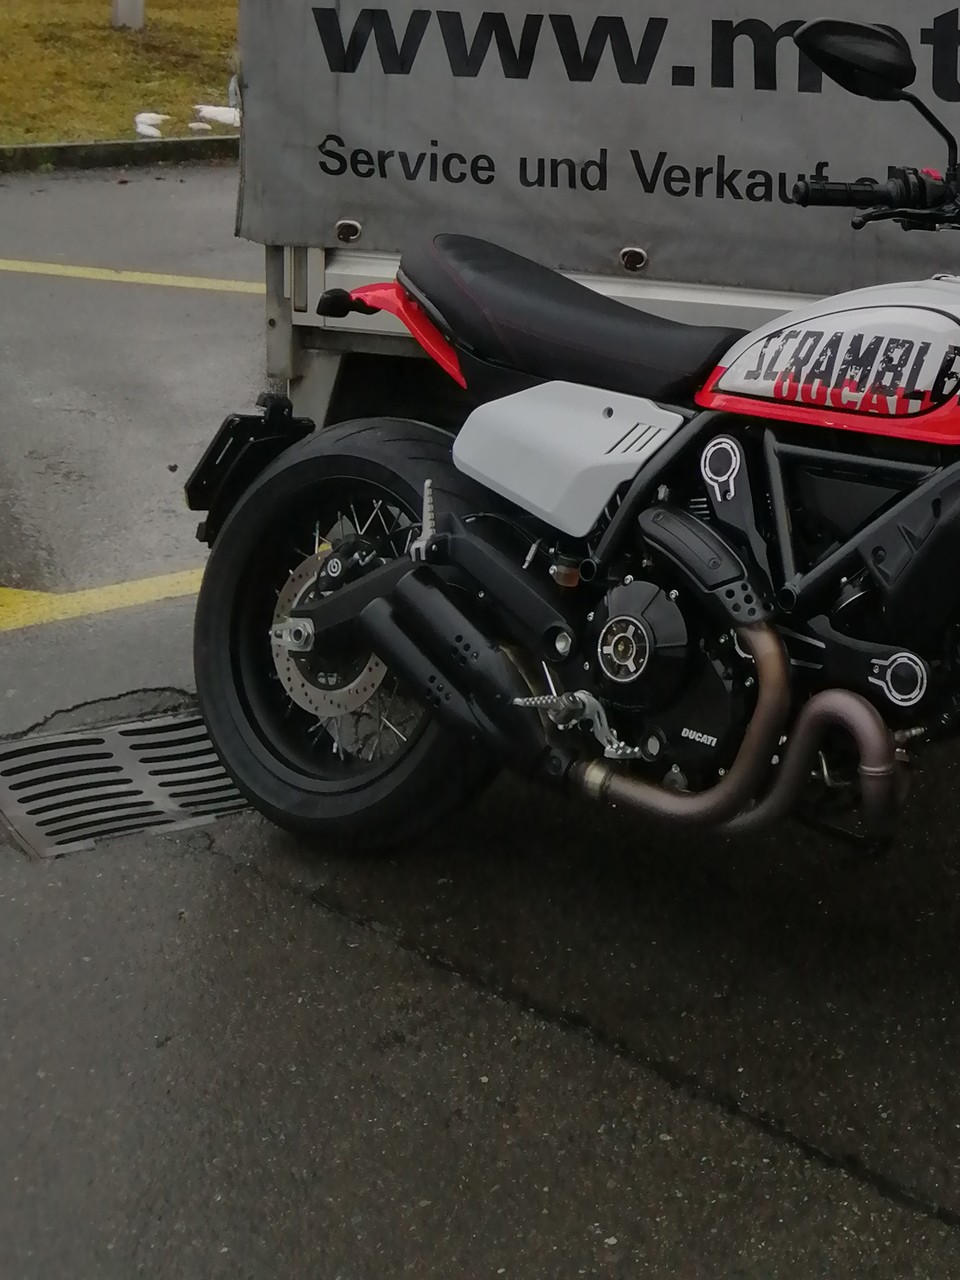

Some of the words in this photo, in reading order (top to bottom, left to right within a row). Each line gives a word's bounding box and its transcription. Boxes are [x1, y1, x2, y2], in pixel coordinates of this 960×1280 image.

[317, 134, 496, 184] Service
[519, 148, 608, 191] und
[681, 727, 718, 747] DUCATI
